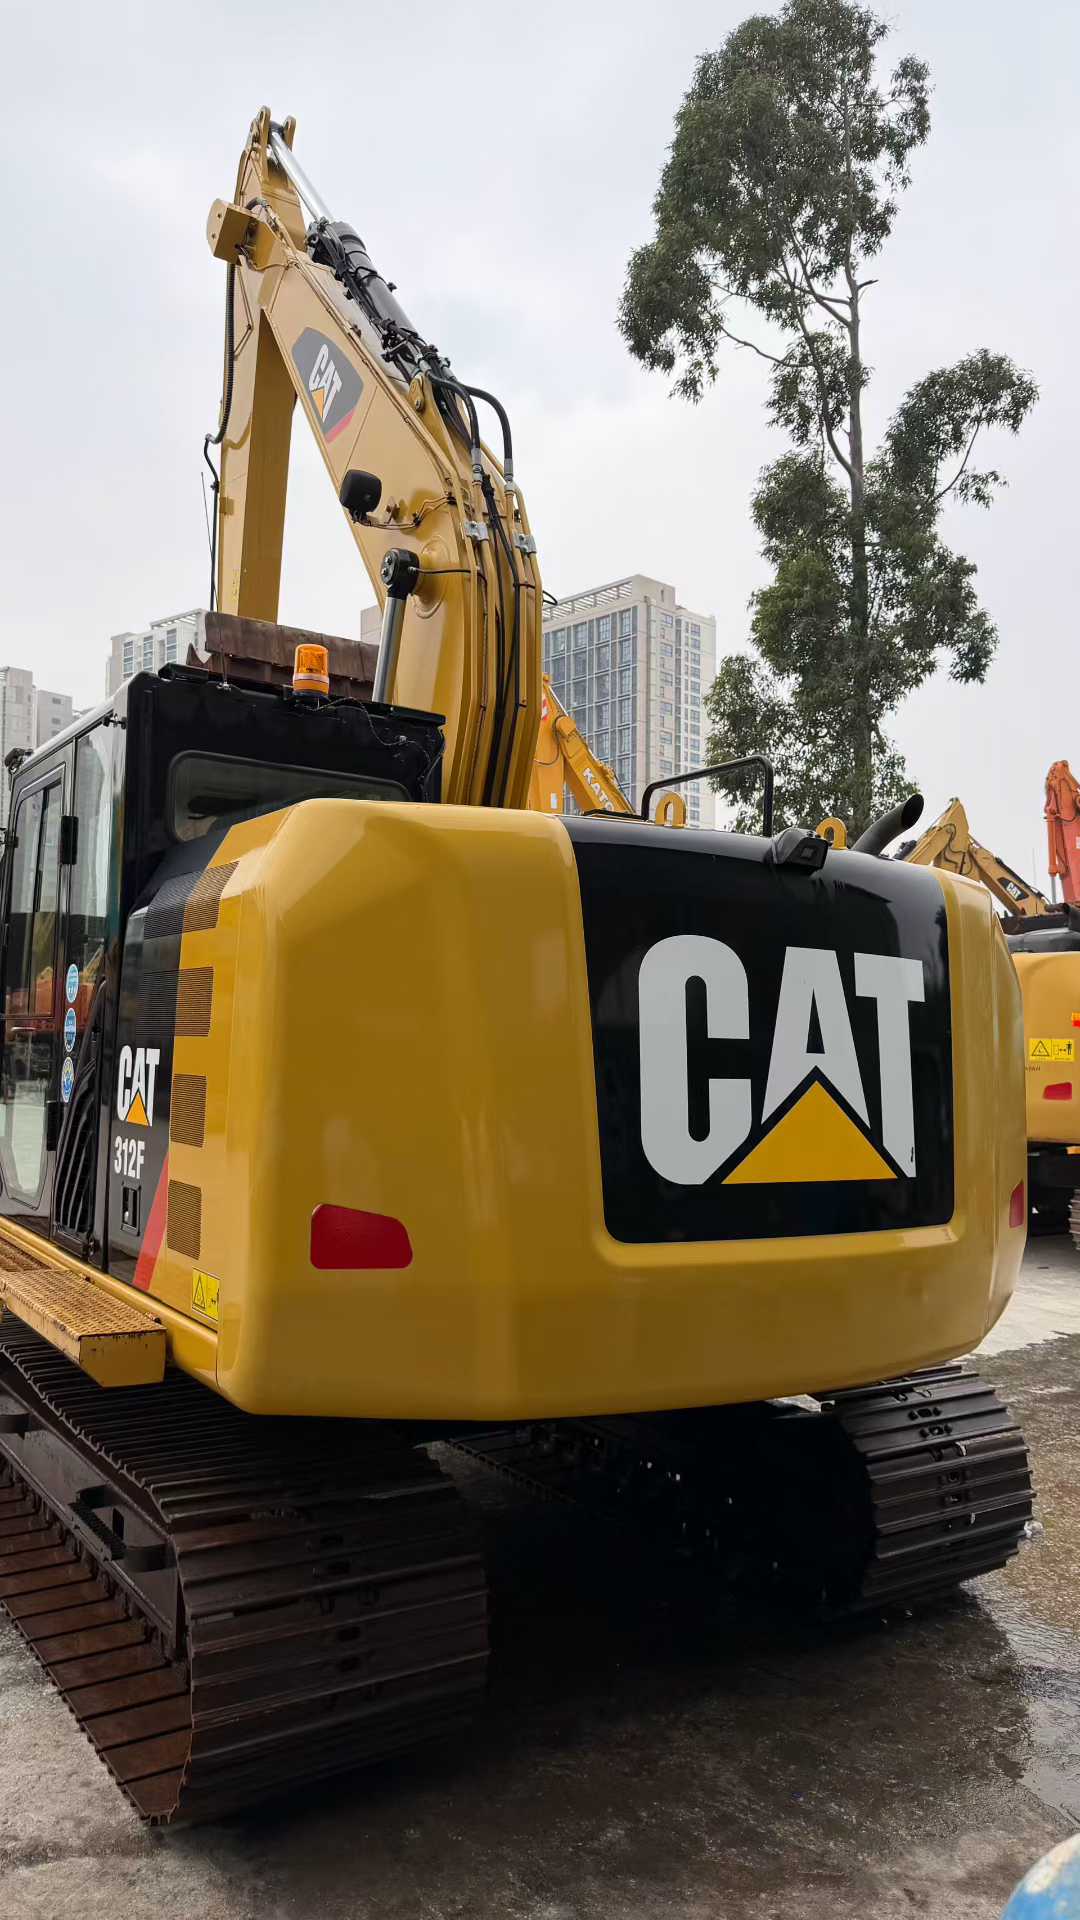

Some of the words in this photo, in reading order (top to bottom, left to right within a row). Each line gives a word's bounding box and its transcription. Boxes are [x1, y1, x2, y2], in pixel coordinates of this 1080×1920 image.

[309, 344, 342, 423] CAT
[117, 1045, 160, 1127] CAT
[639, 935, 925, 1184] CAT
[114, 1136, 145, 1179] 312F
